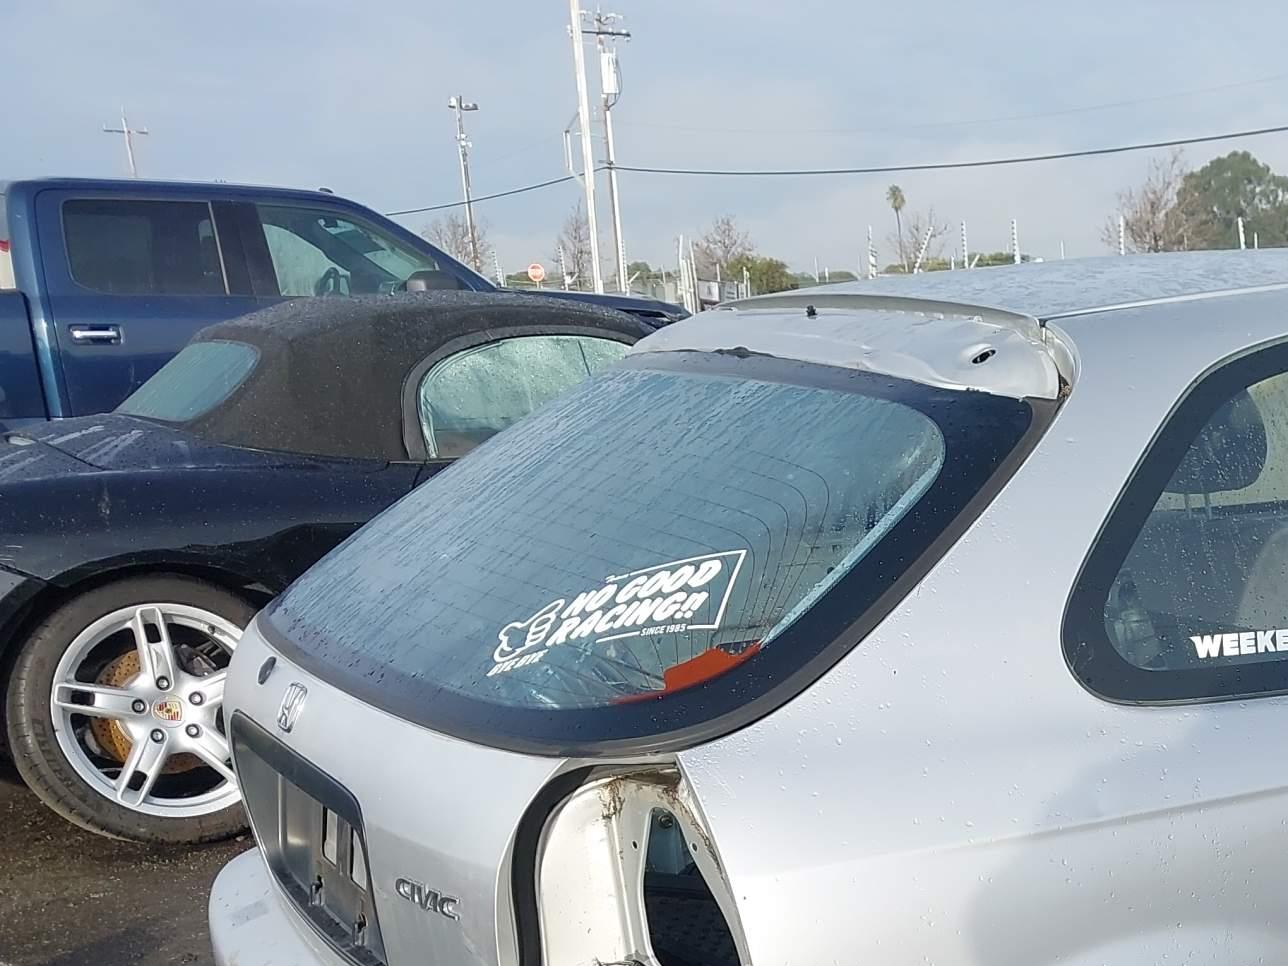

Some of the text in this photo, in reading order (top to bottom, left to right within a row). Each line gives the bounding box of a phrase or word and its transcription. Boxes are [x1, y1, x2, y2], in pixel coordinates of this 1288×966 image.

[560, 559, 721, 619] NO GOOD
[545, 591, 709, 647] RACING!!
[640, 623, 687, 637] SINCE 1985
[395, 878, 460, 921] CIVIC
